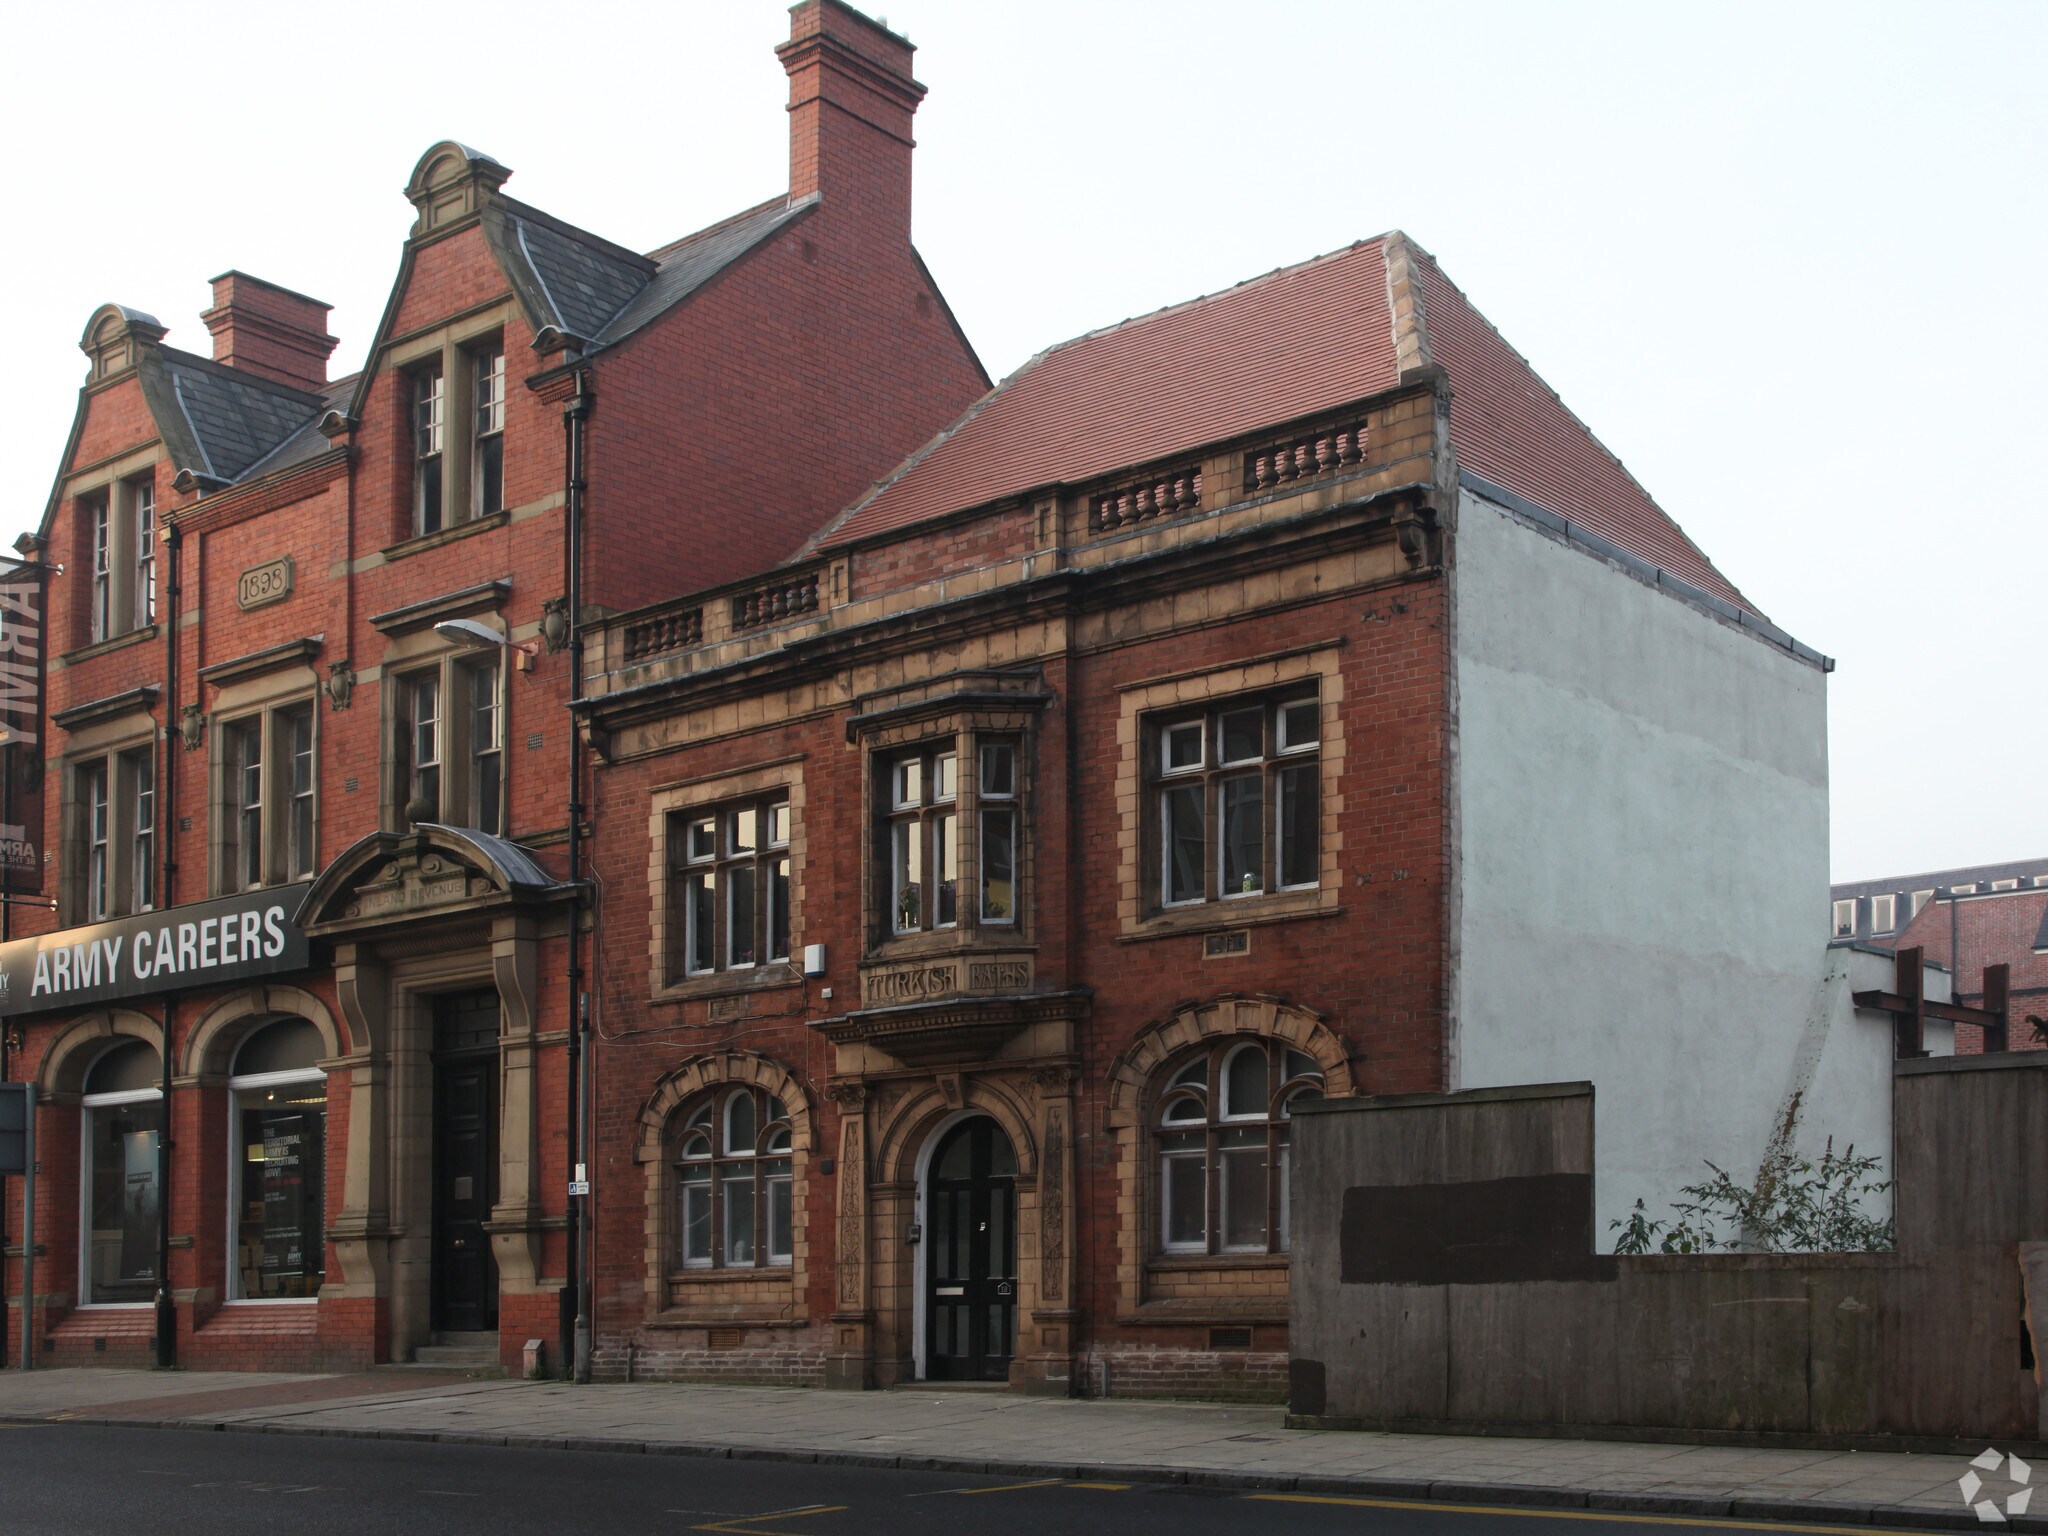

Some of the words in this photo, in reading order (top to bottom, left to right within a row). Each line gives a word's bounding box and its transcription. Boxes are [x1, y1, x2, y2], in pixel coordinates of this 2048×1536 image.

[243, 568, 283, 601] 1898
[410, 881, 461, 906] REVENUE
[31, 936, 123, 998] ARMY
[133, 905, 285, 980] CAREERS
[868, 966, 957, 999] TURKISH
[971, 962, 1028, 988] BATHS
[263, 1128, 275, 1138] THE
